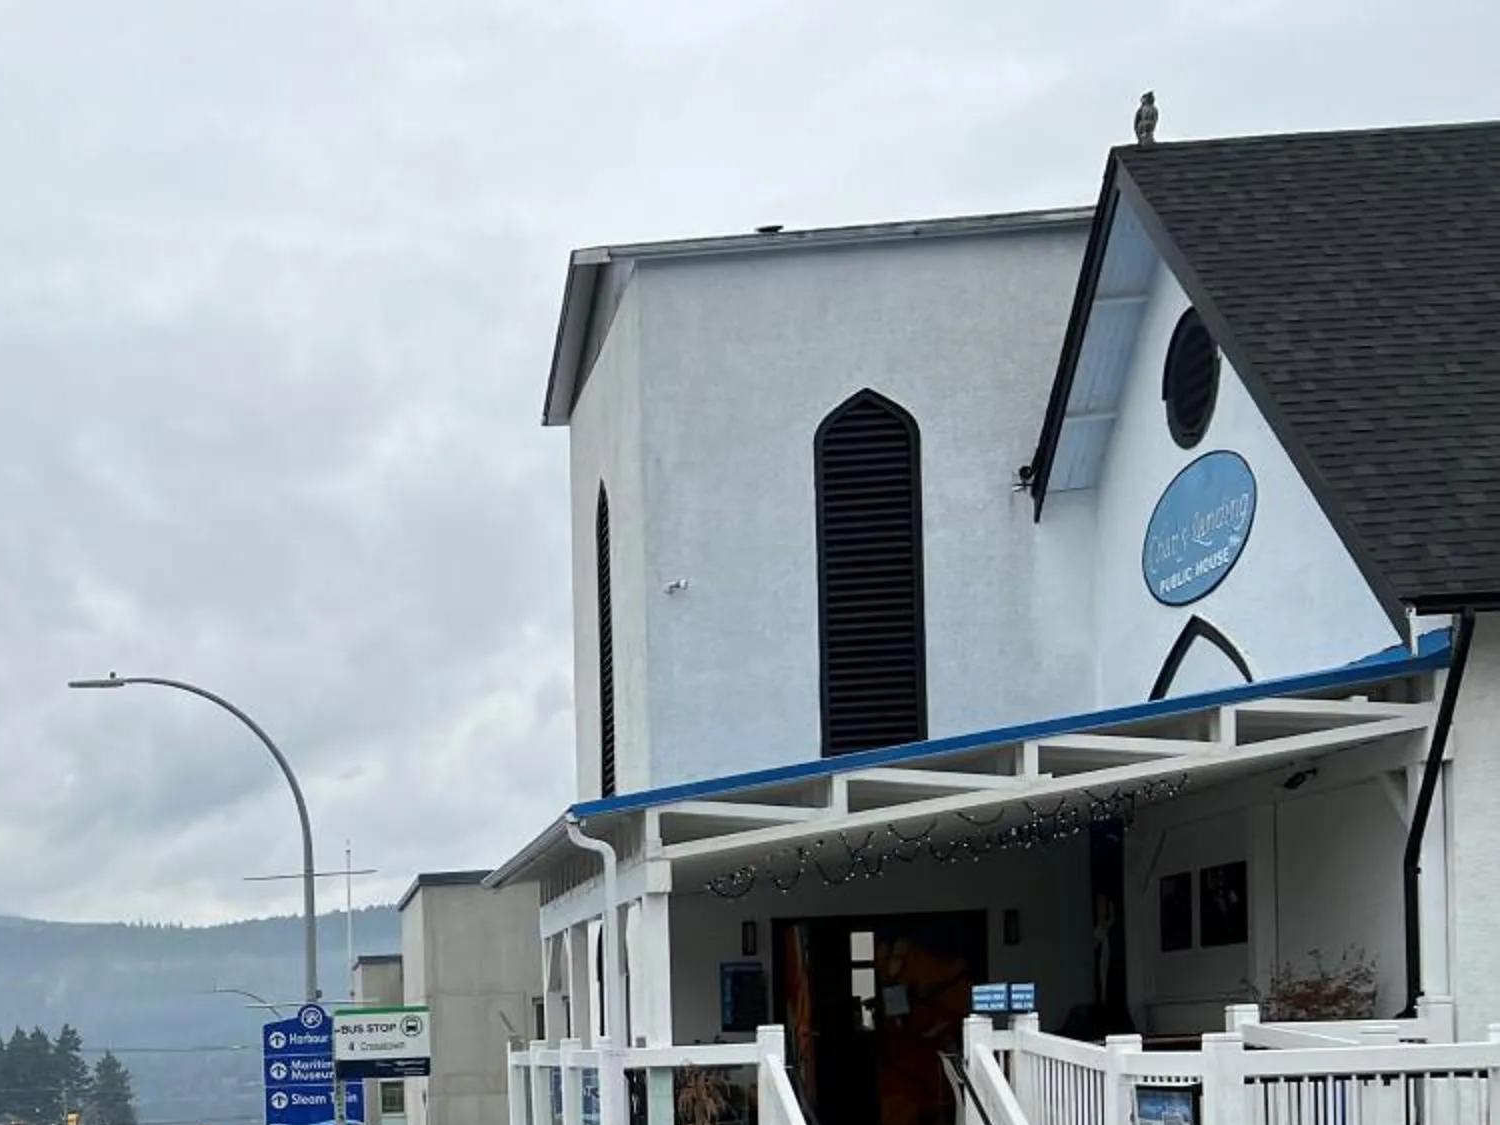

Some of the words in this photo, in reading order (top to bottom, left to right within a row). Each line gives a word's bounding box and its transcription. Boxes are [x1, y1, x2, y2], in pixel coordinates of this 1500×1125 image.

[1159, 566, 1193, 595] PUBLIC
[1194, 546, 1230, 577] HOUSE
[340, 1024, 365, 1035] BUS
[366, 1022, 398, 1034] STOP
[289, 1032, 329, 1045] Harbour
[291, 1059, 335, 1070] Maritim
[291, 1093, 327, 1105] Steam
